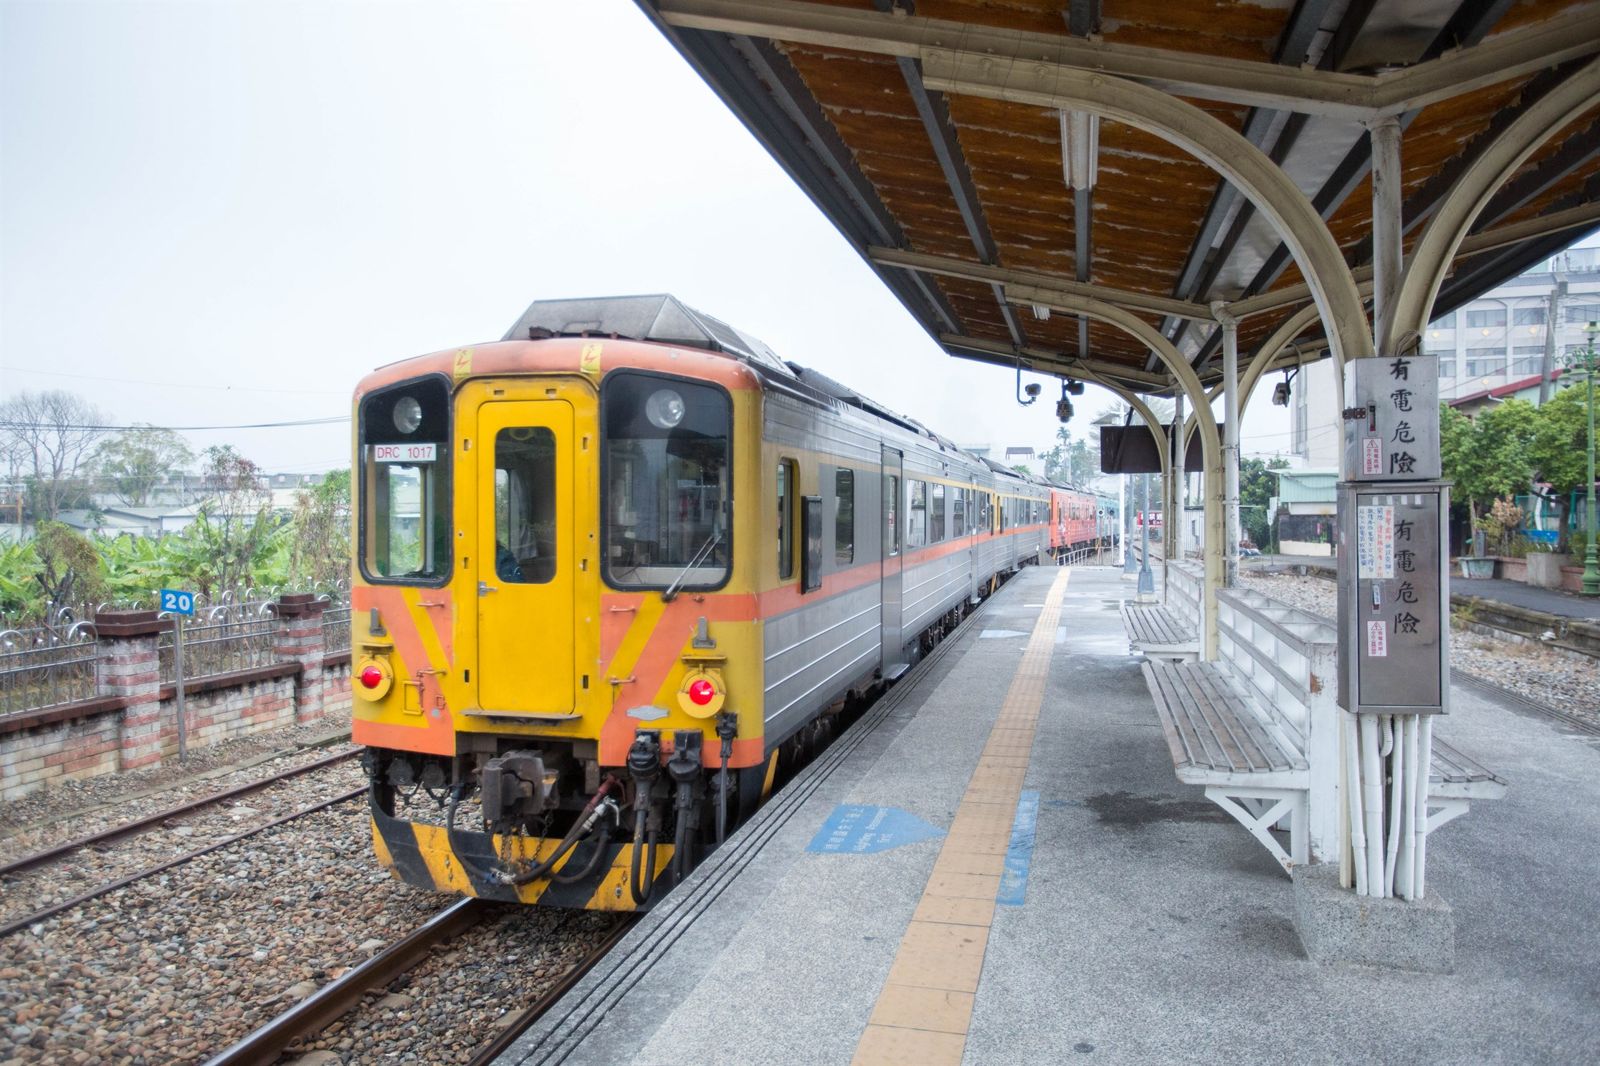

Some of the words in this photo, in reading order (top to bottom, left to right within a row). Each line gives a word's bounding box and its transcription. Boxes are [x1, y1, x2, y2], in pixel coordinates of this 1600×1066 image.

[1390, 358, 1417, 475] 有電危險
[377, 446, 400, 459] DRC
[408, 446, 432, 459] 1017
[165, 593, 190, 611] 20
[1394, 519, 1421, 634] 有電危險
